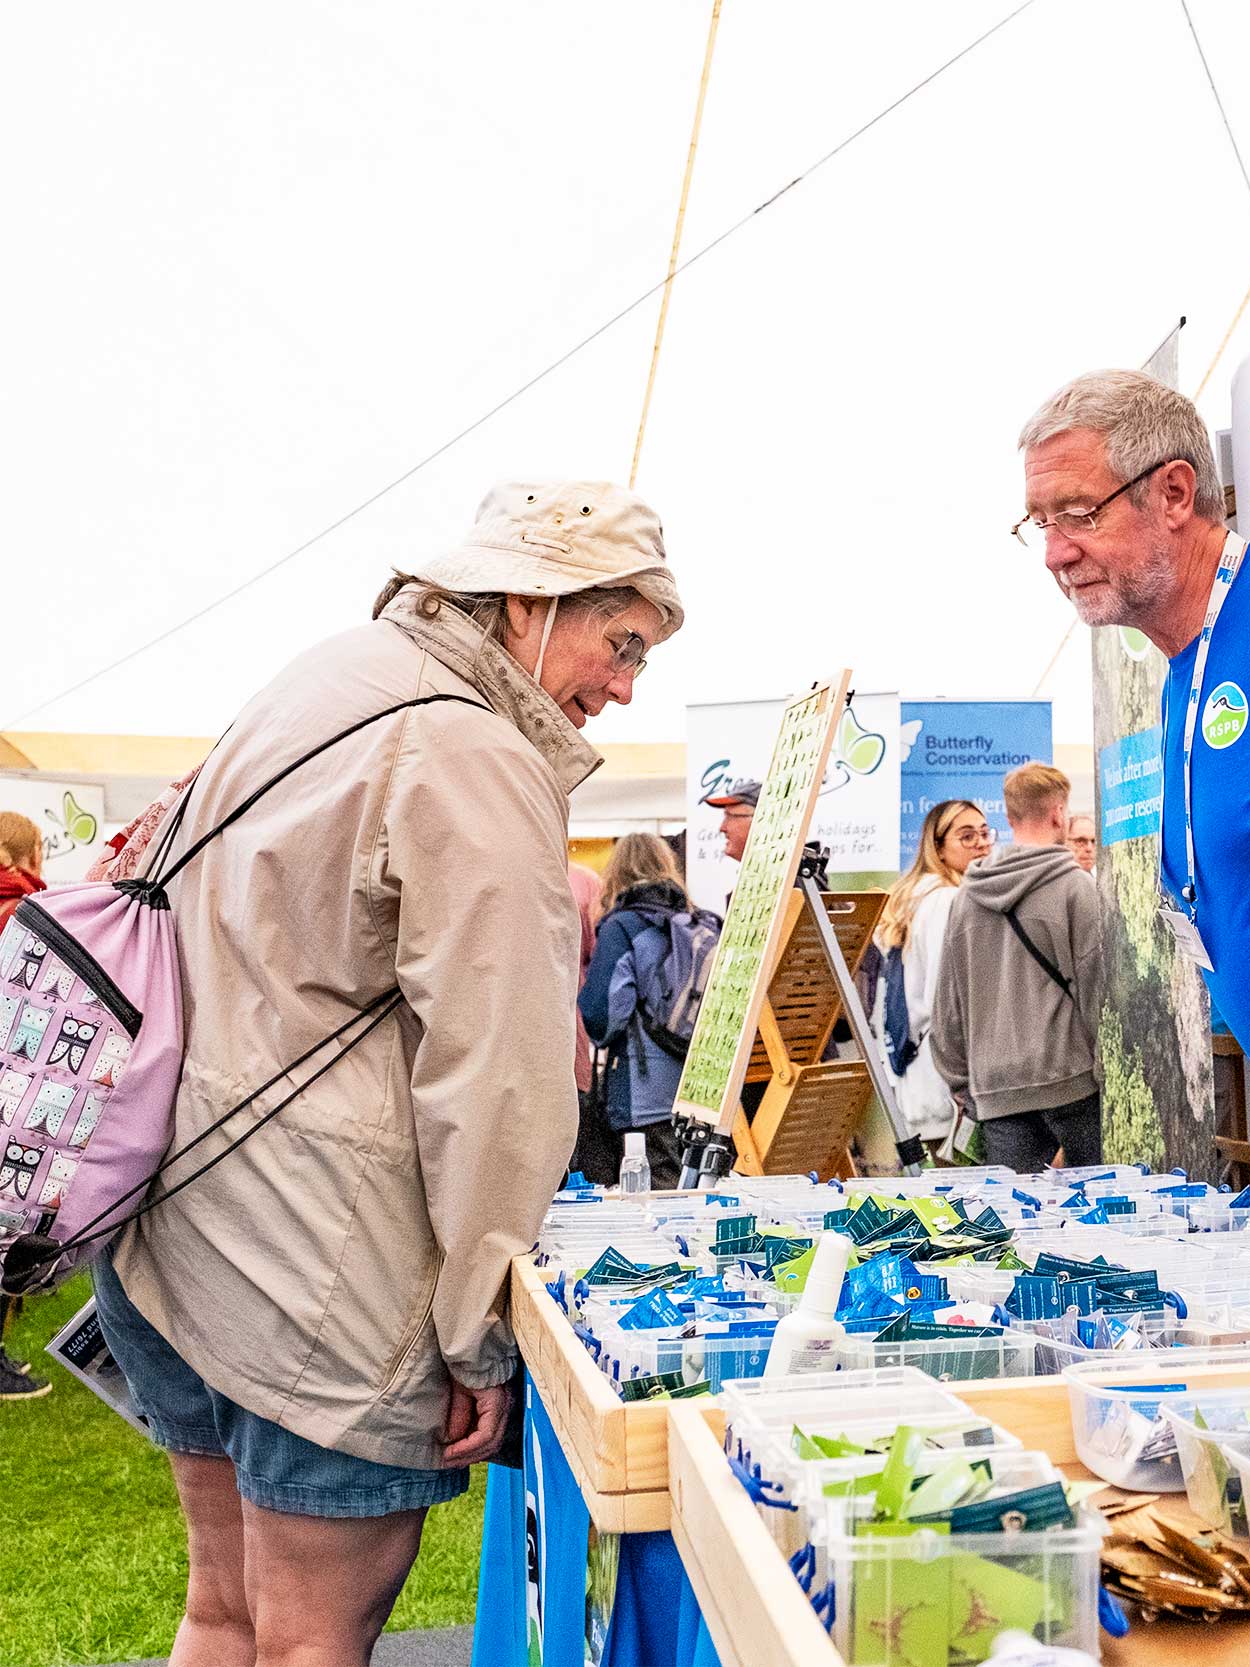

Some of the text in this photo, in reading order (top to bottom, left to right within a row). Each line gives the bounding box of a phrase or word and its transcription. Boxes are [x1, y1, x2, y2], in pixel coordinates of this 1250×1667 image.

[1208, 719, 1240, 739] RSPB
[926, 735, 994, 751] Butterfly
[926, 751, 1031, 766] Conservation
[1123, 755, 1142, 783] after
